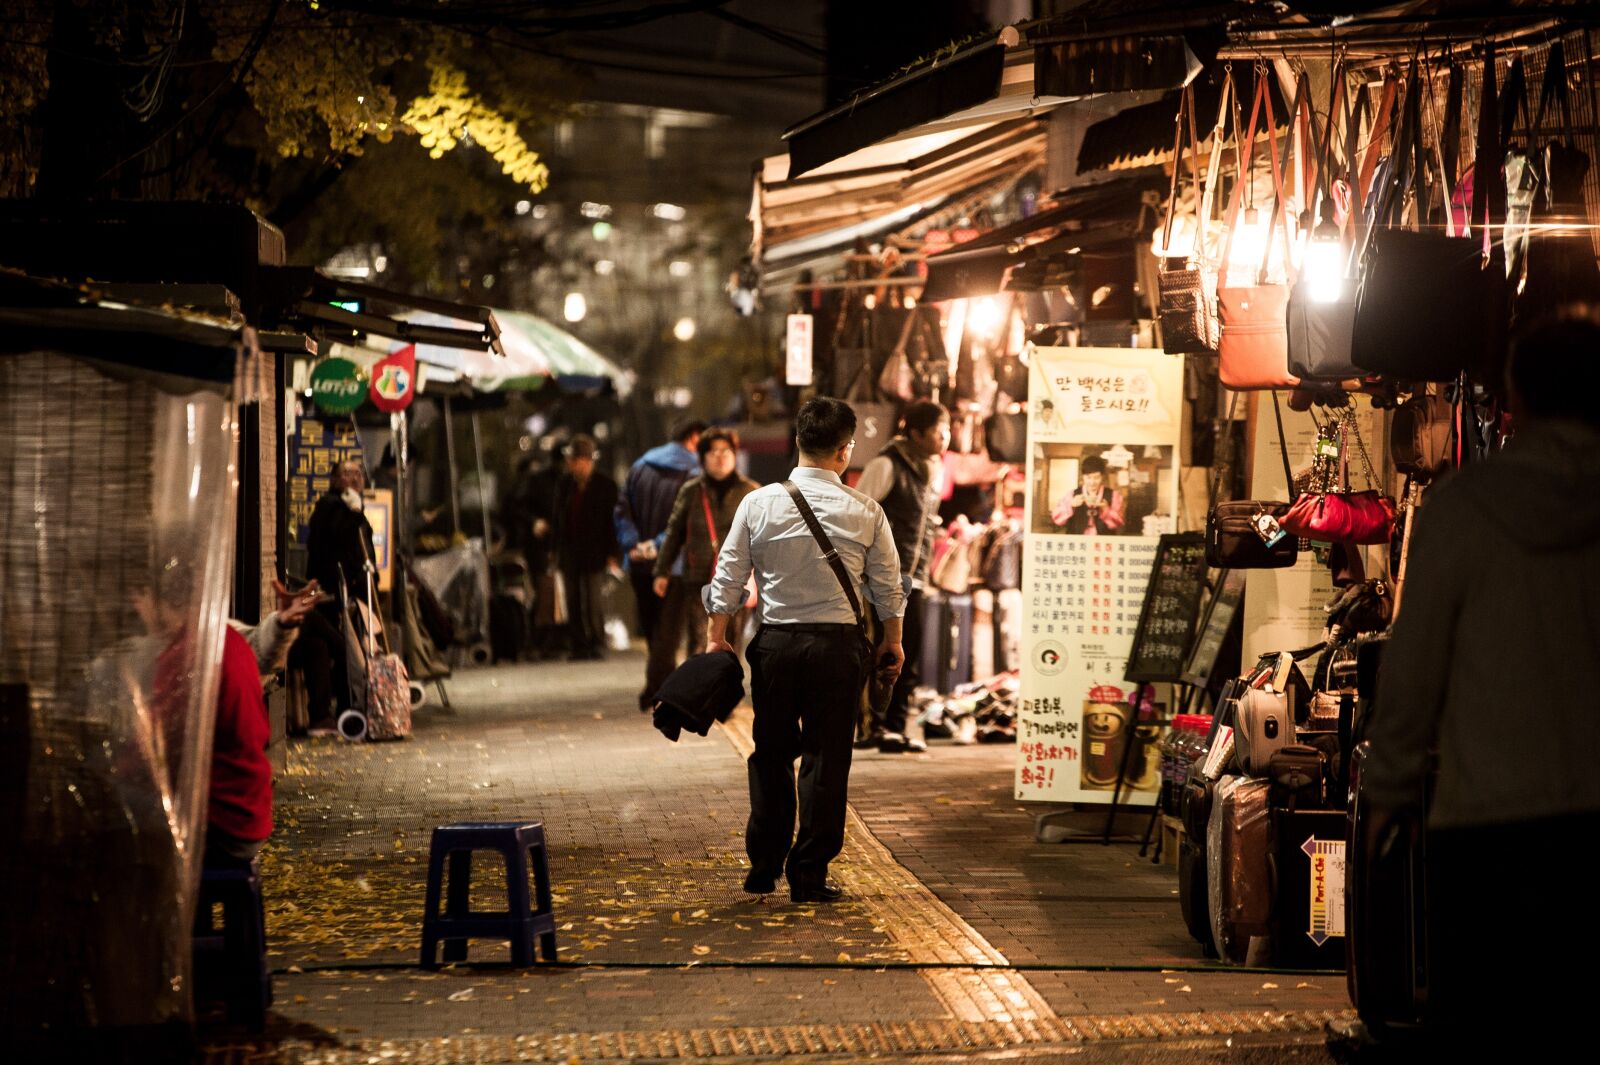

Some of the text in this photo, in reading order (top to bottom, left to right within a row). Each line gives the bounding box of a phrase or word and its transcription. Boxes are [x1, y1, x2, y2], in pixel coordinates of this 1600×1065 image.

[313, 380, 360, 397] LOTTO
[1056, 376, 1125, 392] 만 백성은
[1081, 396, 1149, 413] 들으시오!!
[864, 416, 878, 438] S
[1021, 742, 1078, 762] 쌍화차가
